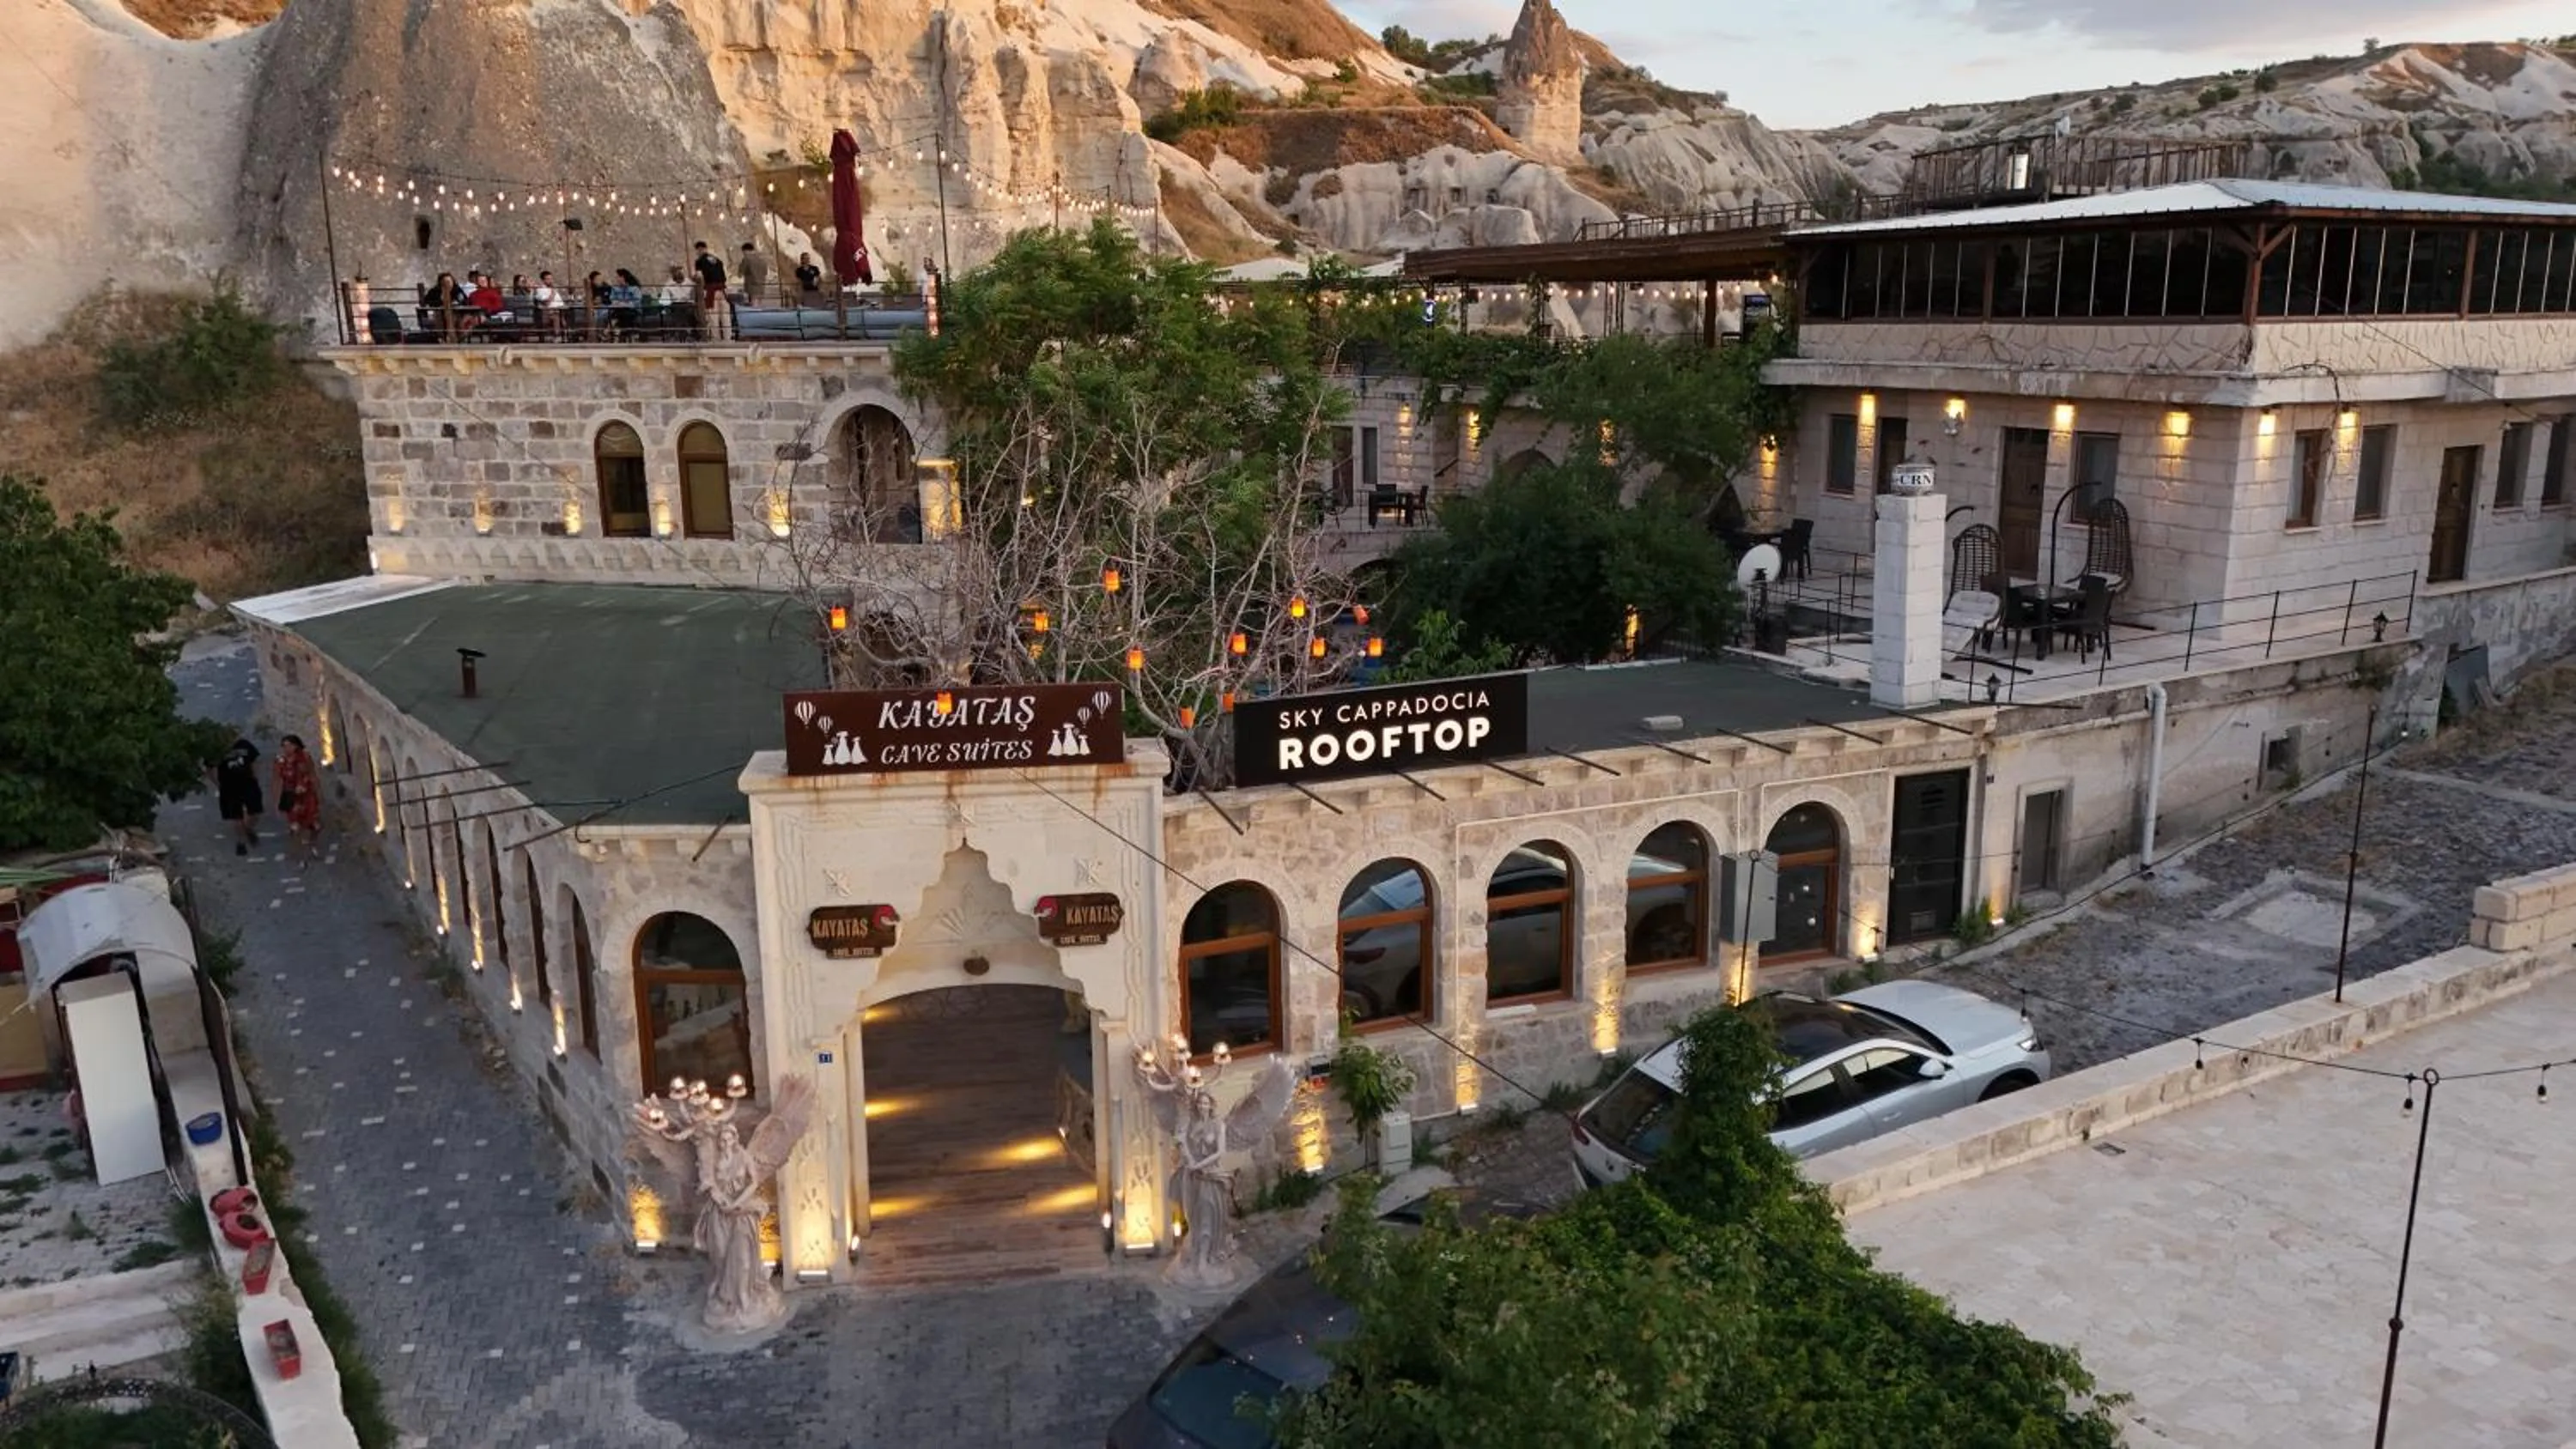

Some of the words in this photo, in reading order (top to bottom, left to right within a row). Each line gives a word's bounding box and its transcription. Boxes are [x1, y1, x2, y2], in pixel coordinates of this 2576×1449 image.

[1279, 708, 1323, 730] SKY
[1337, 691, 1490, 723] CAPPADOCIA
[881, 744, 941, 765] CAVE
[1279, 717, 1490, 770] ROOFTOP
